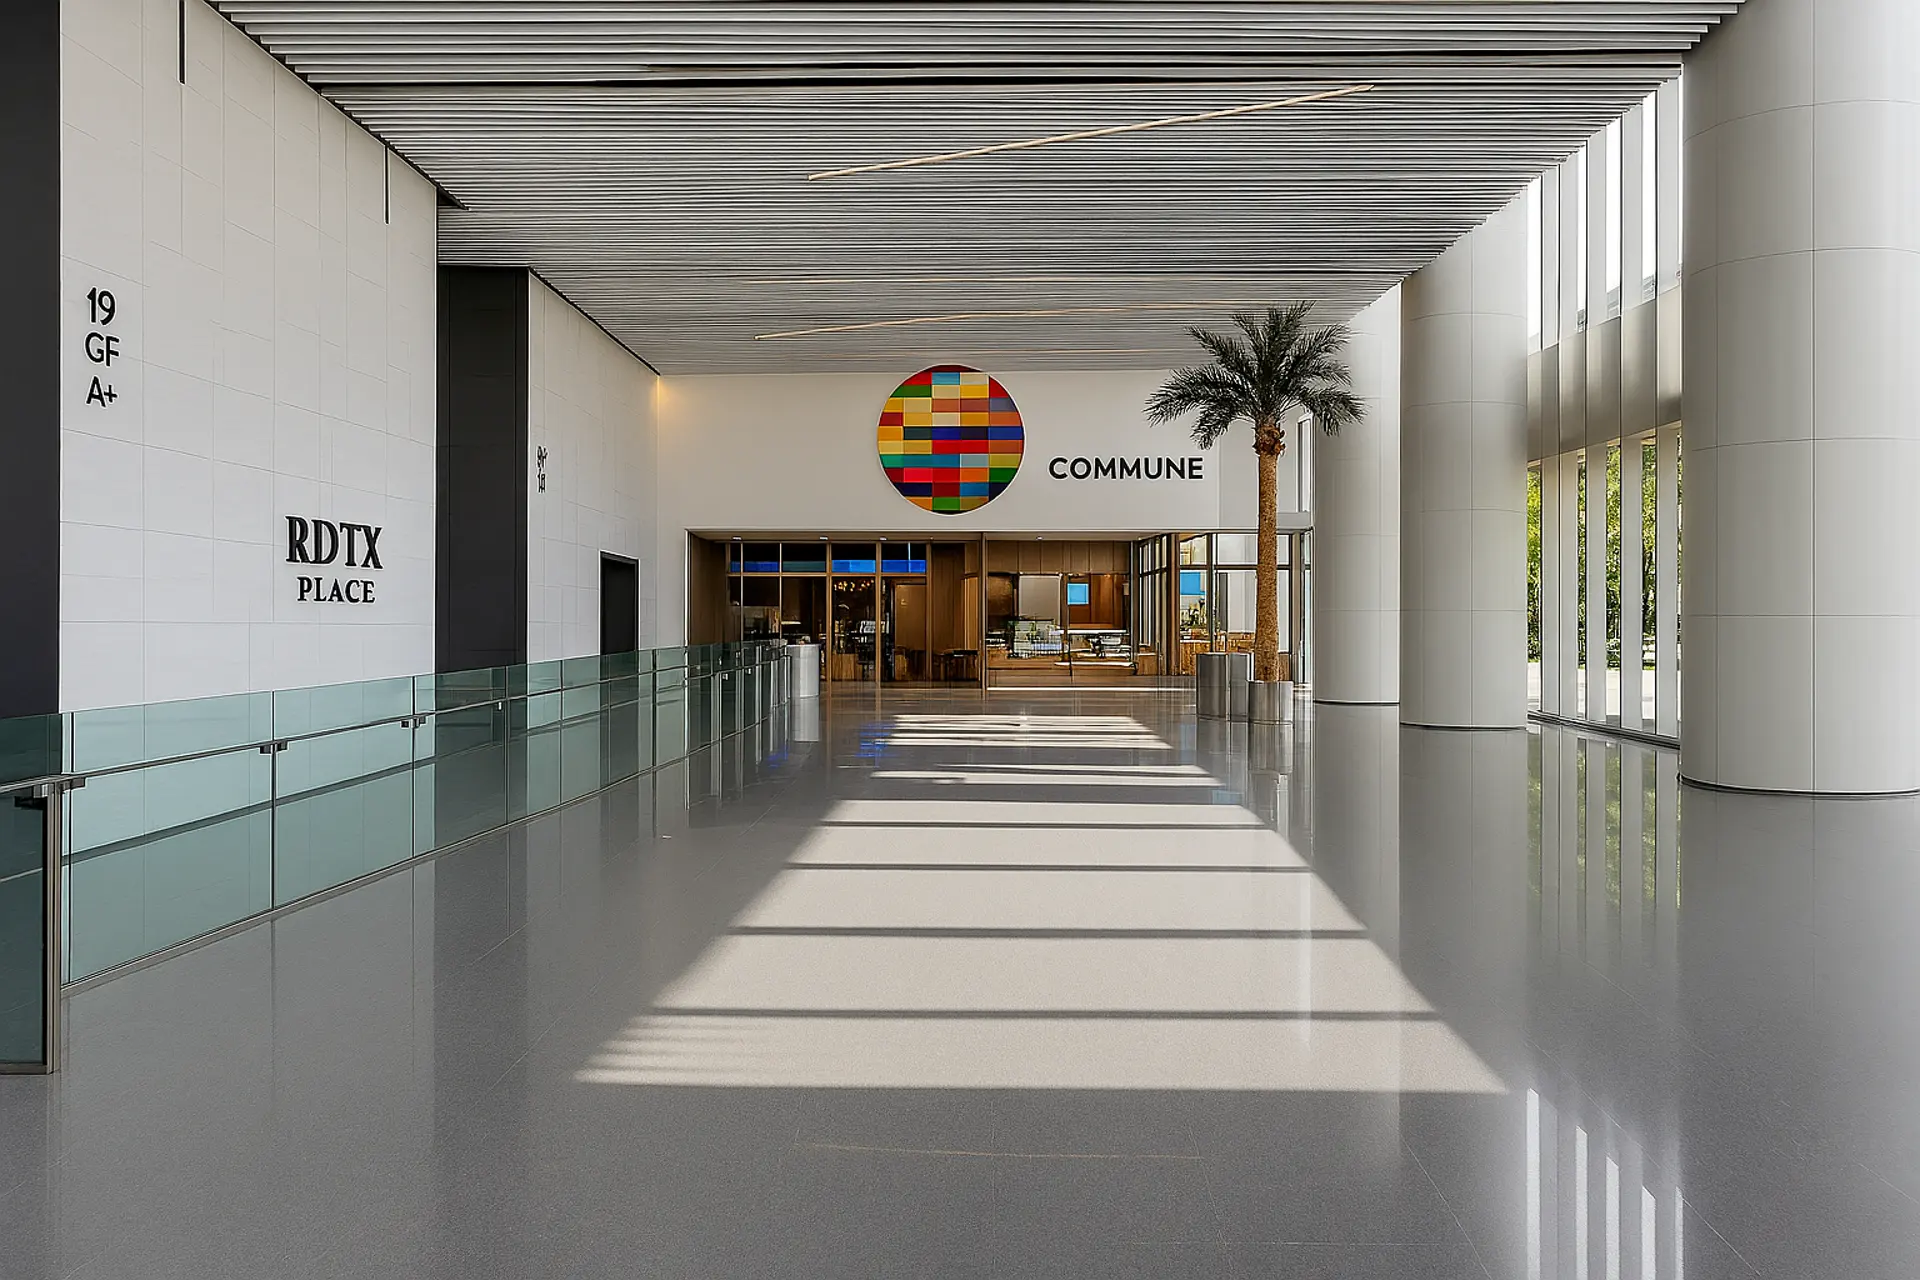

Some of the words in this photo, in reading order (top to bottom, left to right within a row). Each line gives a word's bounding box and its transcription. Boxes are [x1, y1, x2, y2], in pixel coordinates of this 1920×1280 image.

[86, 288, 116, 325] 19
[84, 333, 120, 367] GF
[86, 375, 118, 408] A+
[1049, 457, 1203, 480] COMMUNE
[286, 515, 383, 569] RDTX
[296, 577, 376, 603] PLACE
